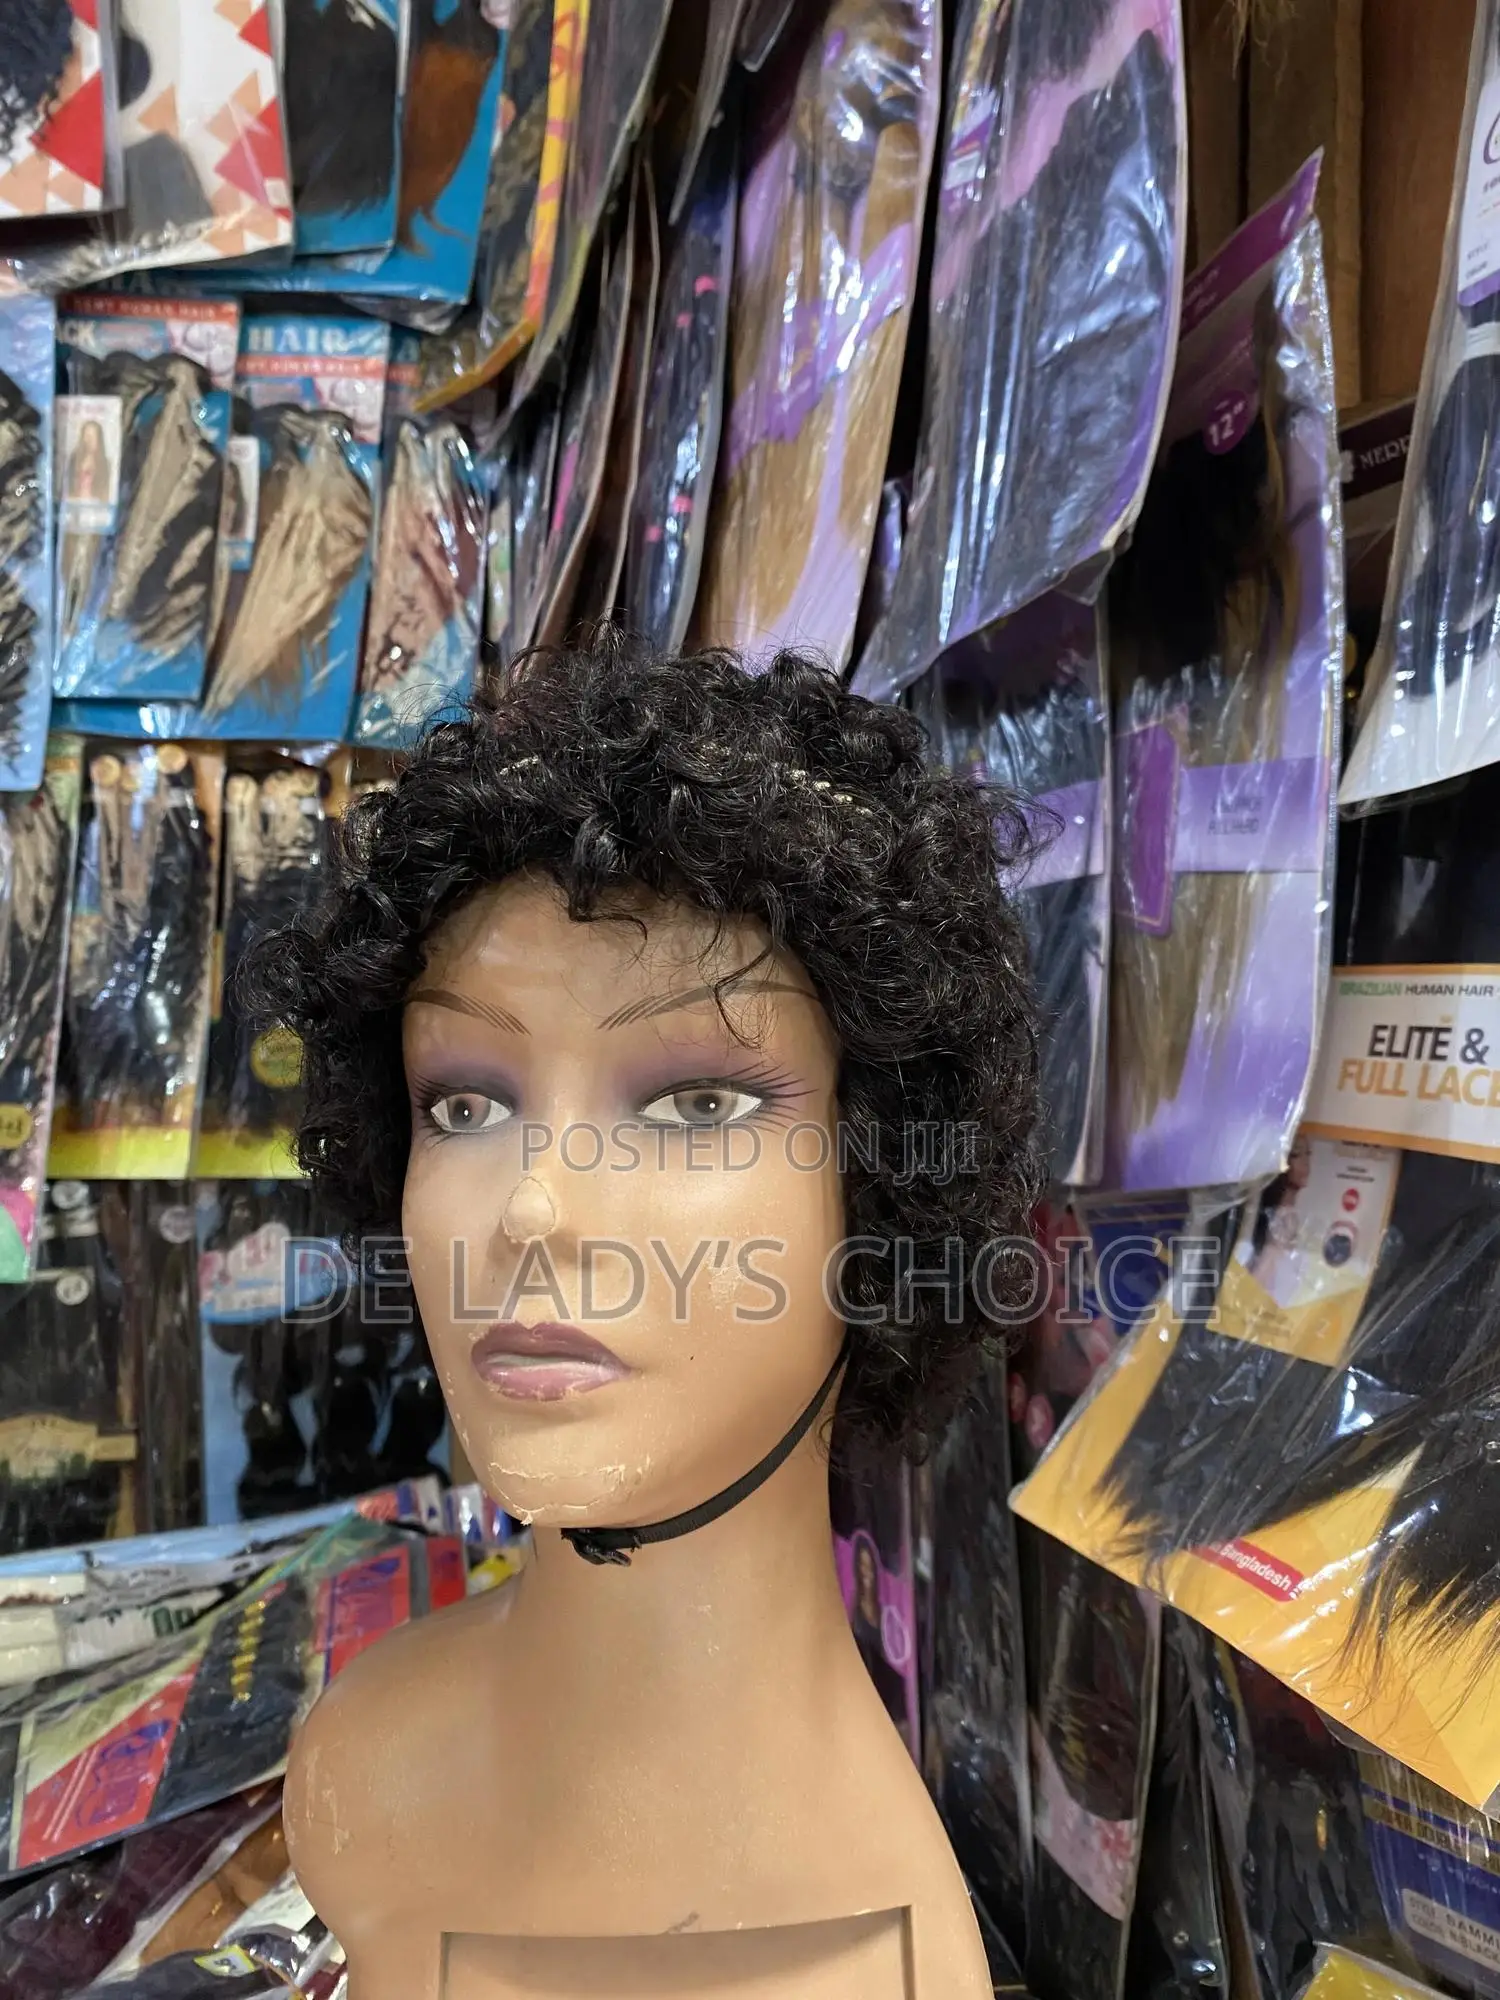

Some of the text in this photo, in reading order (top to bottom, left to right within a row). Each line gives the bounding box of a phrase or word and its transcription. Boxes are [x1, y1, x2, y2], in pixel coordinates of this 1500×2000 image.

[1405, 984, 1454, 997] HUMAN
[1458, 985, 1494, 997] HAIR
[1367, 1024, 1490, 1065] ELITE &
[1336, 1058, 1409, 1097] FULL
